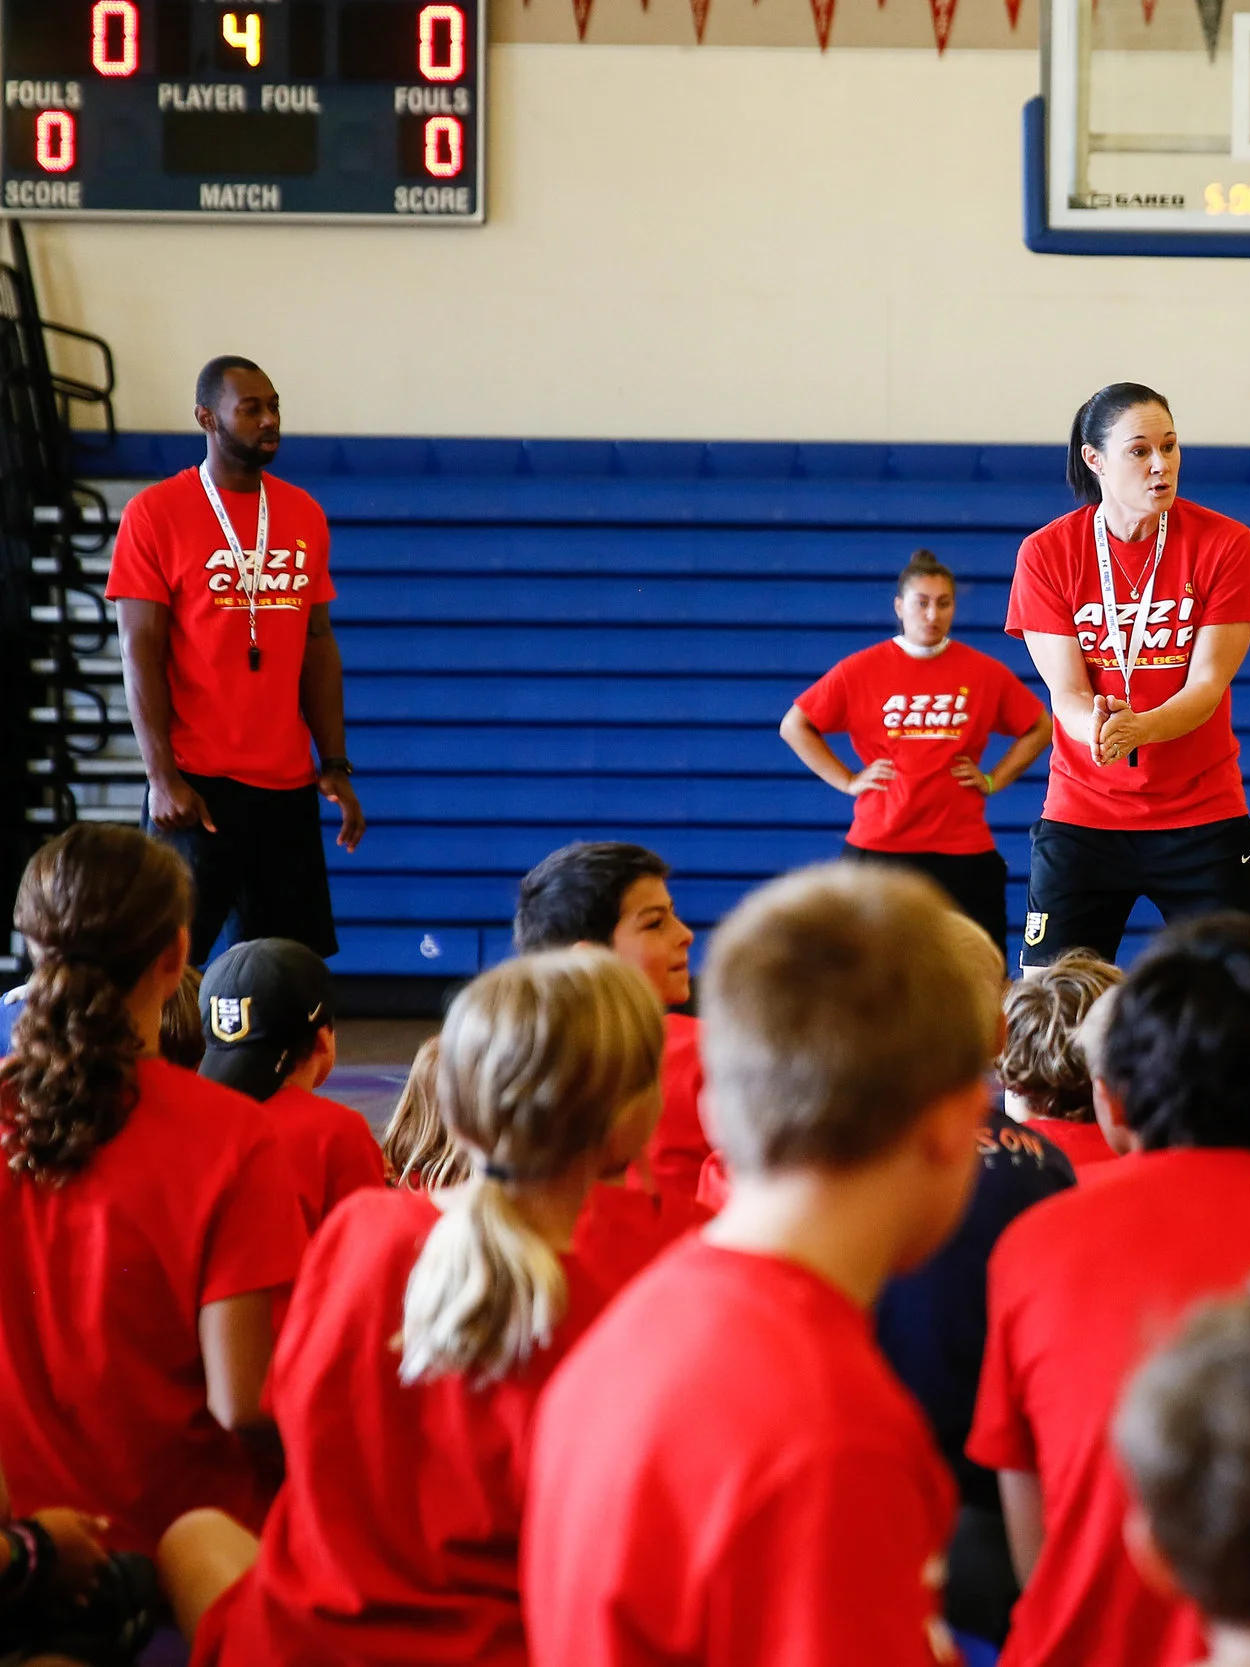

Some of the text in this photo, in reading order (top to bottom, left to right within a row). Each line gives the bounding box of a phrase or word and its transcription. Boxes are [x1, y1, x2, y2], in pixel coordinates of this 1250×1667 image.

[92, 0, 138, 76] 0
[222, 13, 261, 67] 4
[419, 5, 464, 81] 0
[5, 80, 82, 109] FOULS
[158, 83, 321, 112] PLAYER FOUL
[395, 86, 469, 114] FOULS
[36, 110, 75, 172] 0
[424, 116, 462, 177] 0
[5, 181, 82, 208] SCORE
[200, 184, 280, 209] MATCH
[394, 186, 469, 213] SCORE
[883, 711, 969, 728] CAMP
